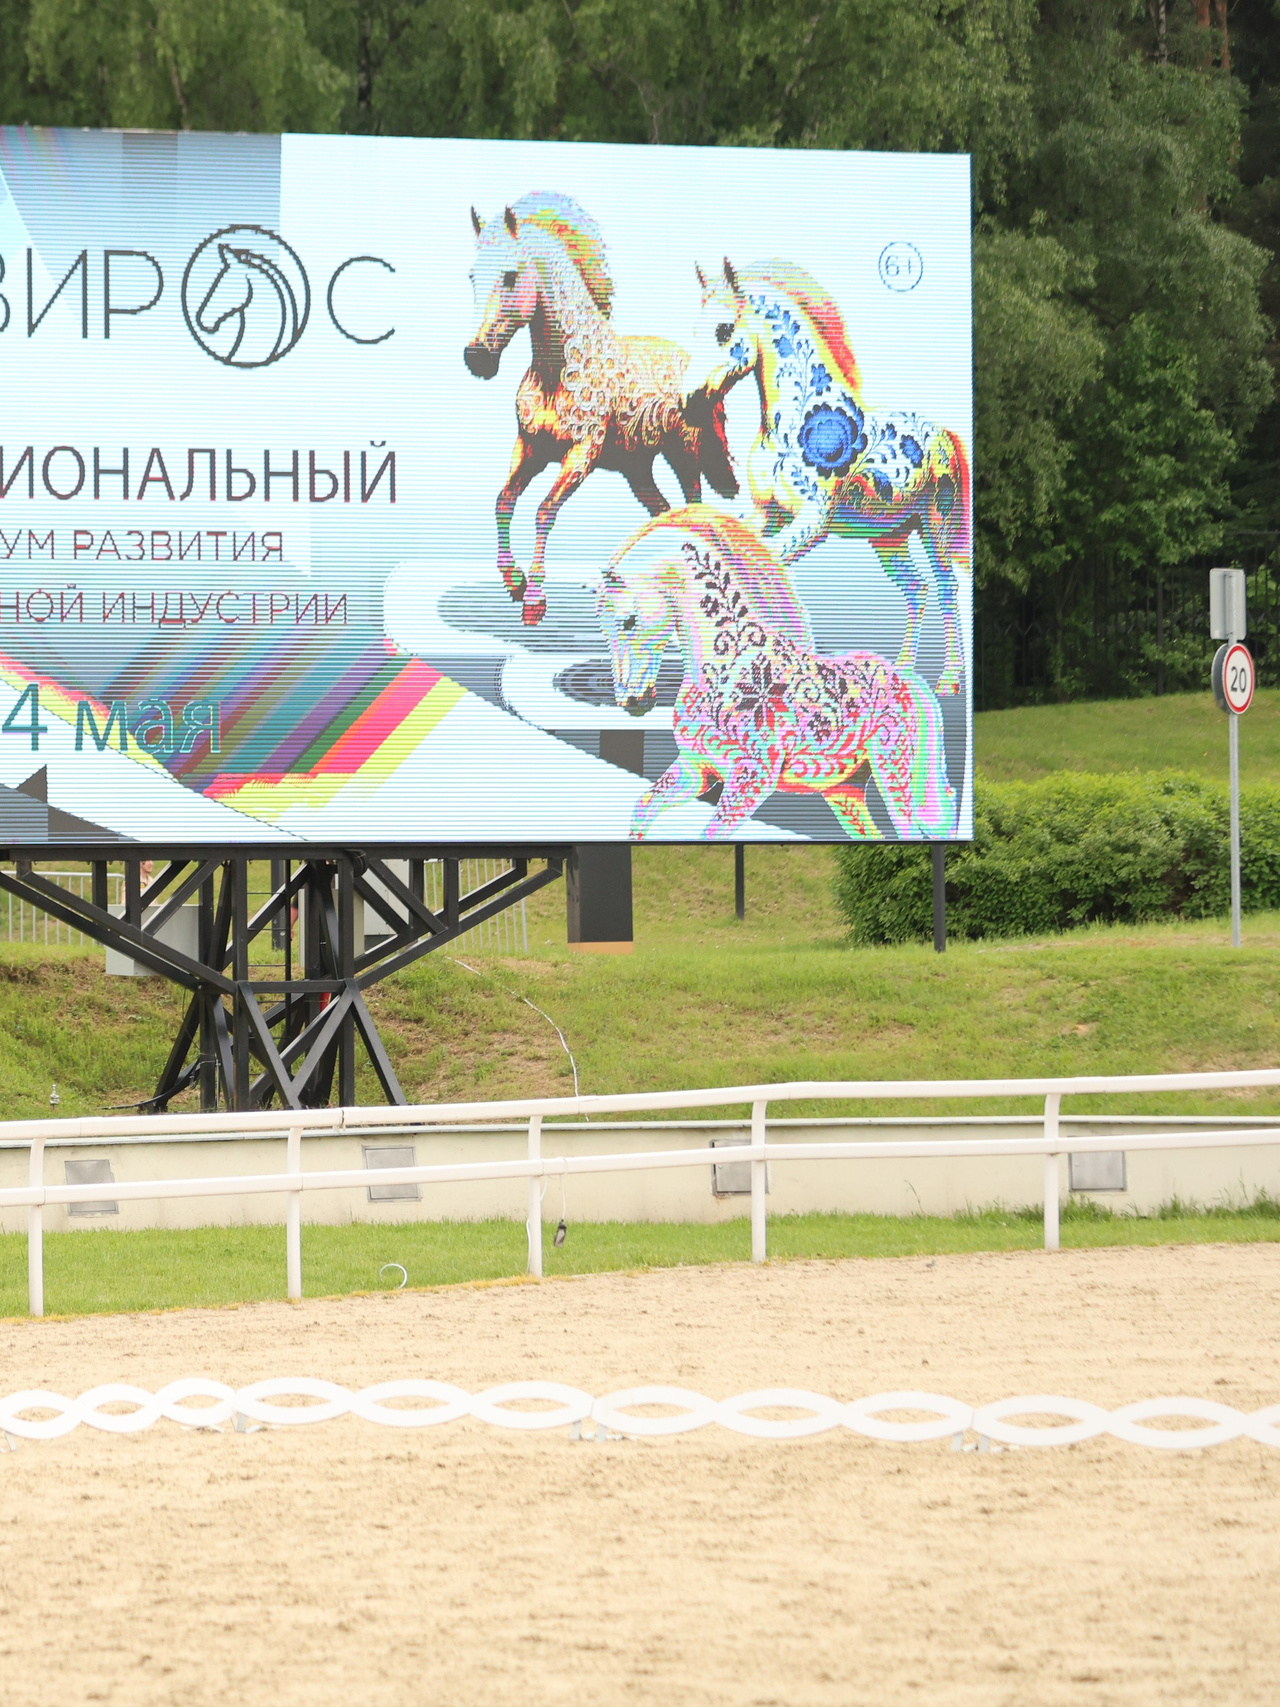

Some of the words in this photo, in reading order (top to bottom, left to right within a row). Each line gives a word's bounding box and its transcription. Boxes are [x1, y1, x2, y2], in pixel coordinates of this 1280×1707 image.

[73, 529, 283, 562] РАЗВИТИЯ
[102, 589, 348, 629] ИНДУСТРИИ
[1230, 665, 1248, 694] 20
[75, 697, 222, 754] мая
